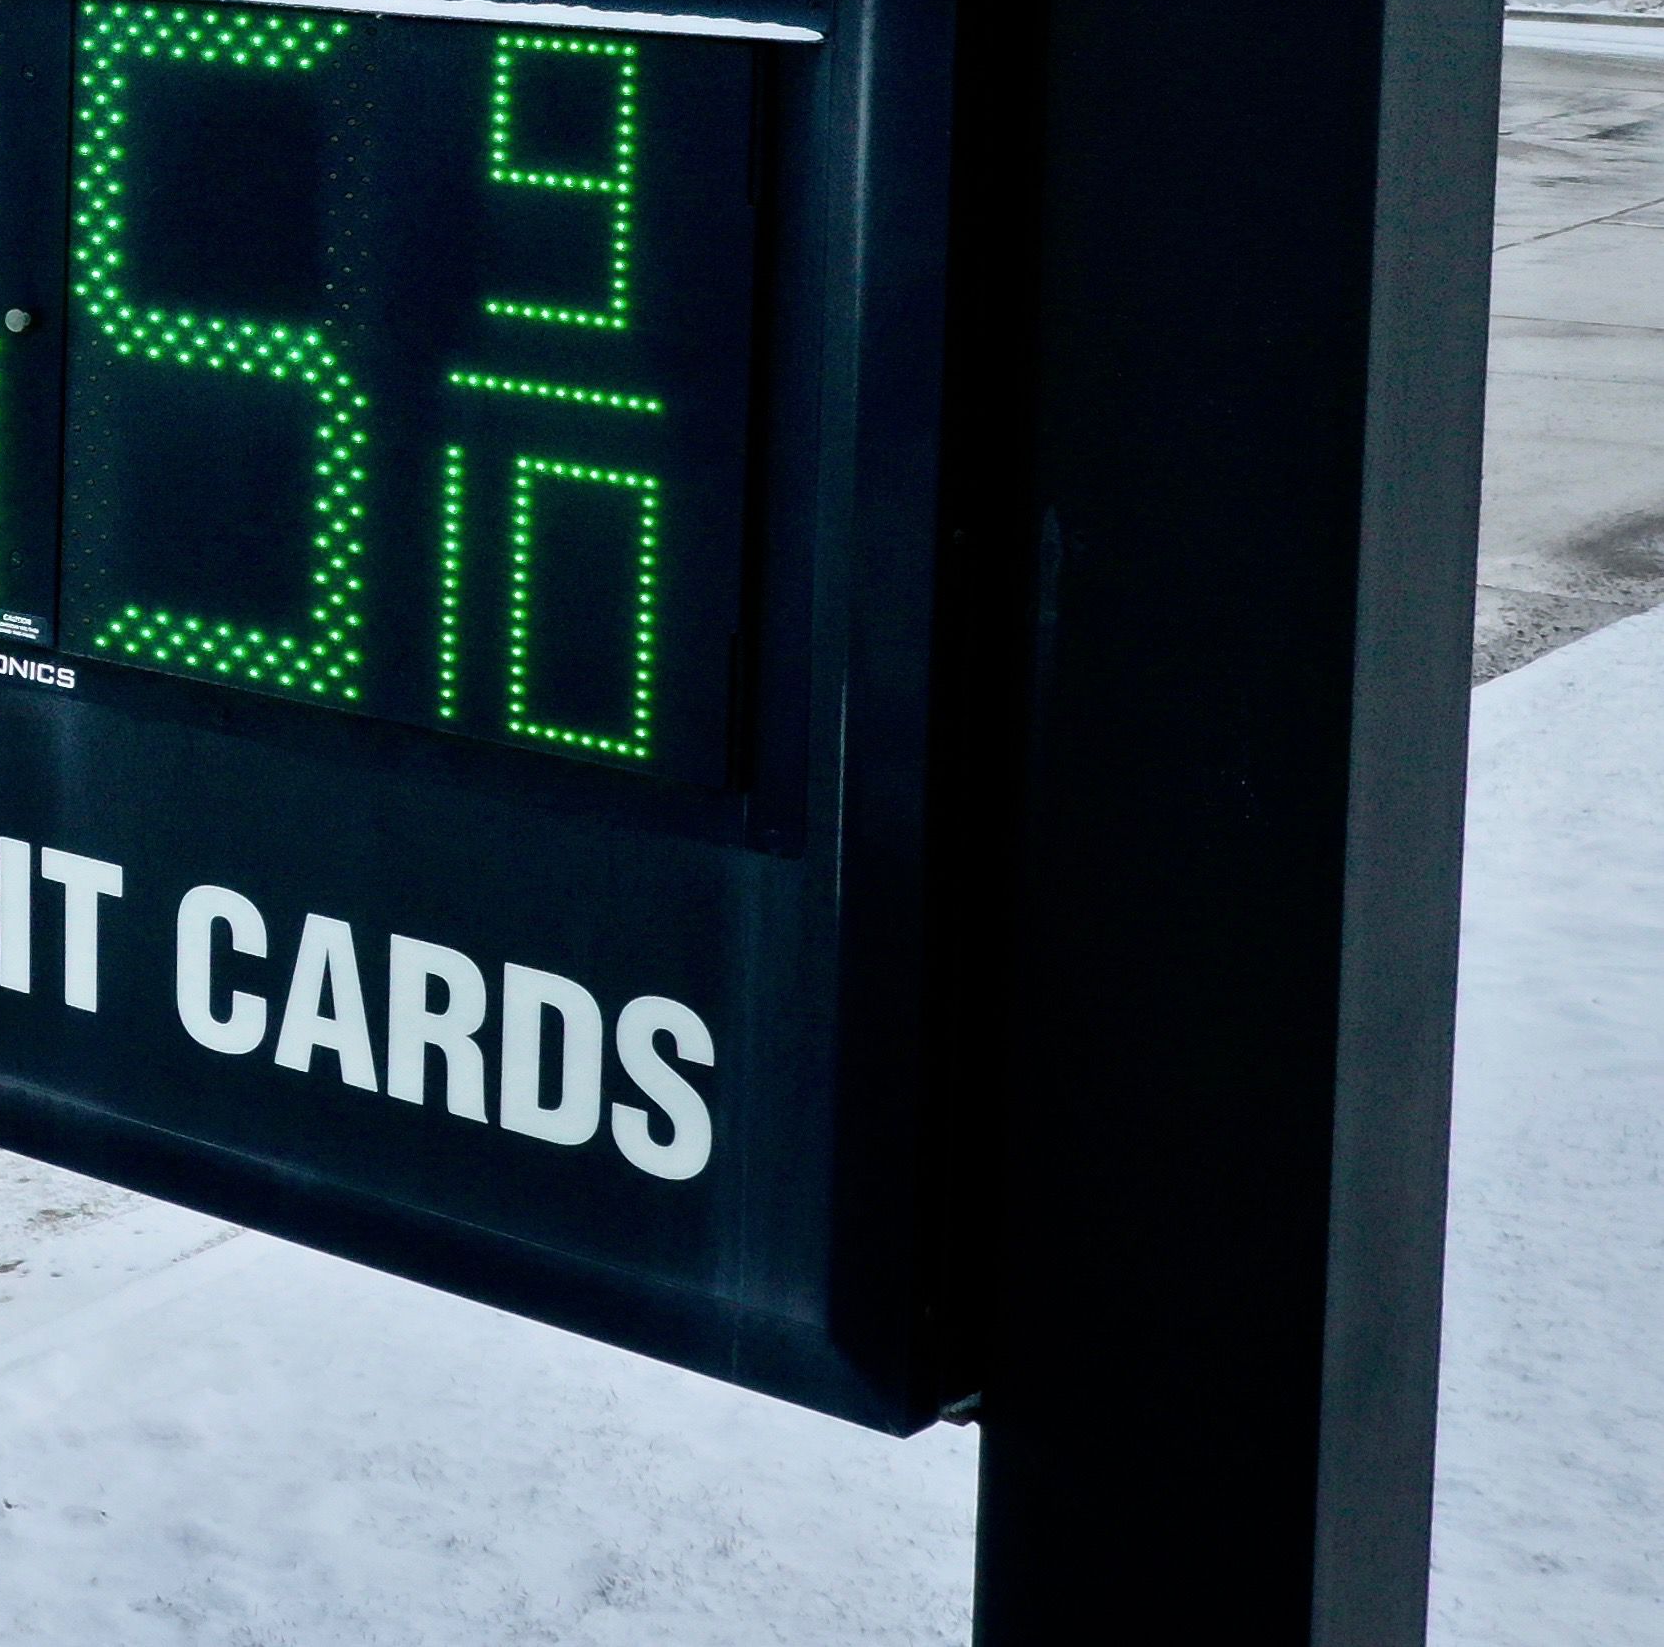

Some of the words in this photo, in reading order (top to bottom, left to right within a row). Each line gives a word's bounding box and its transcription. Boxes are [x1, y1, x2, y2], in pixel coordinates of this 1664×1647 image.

[484, 32, 640, 332] 9
[438, 443, 661, 760] 10
[176, 884, 715, 1180] CARDS
